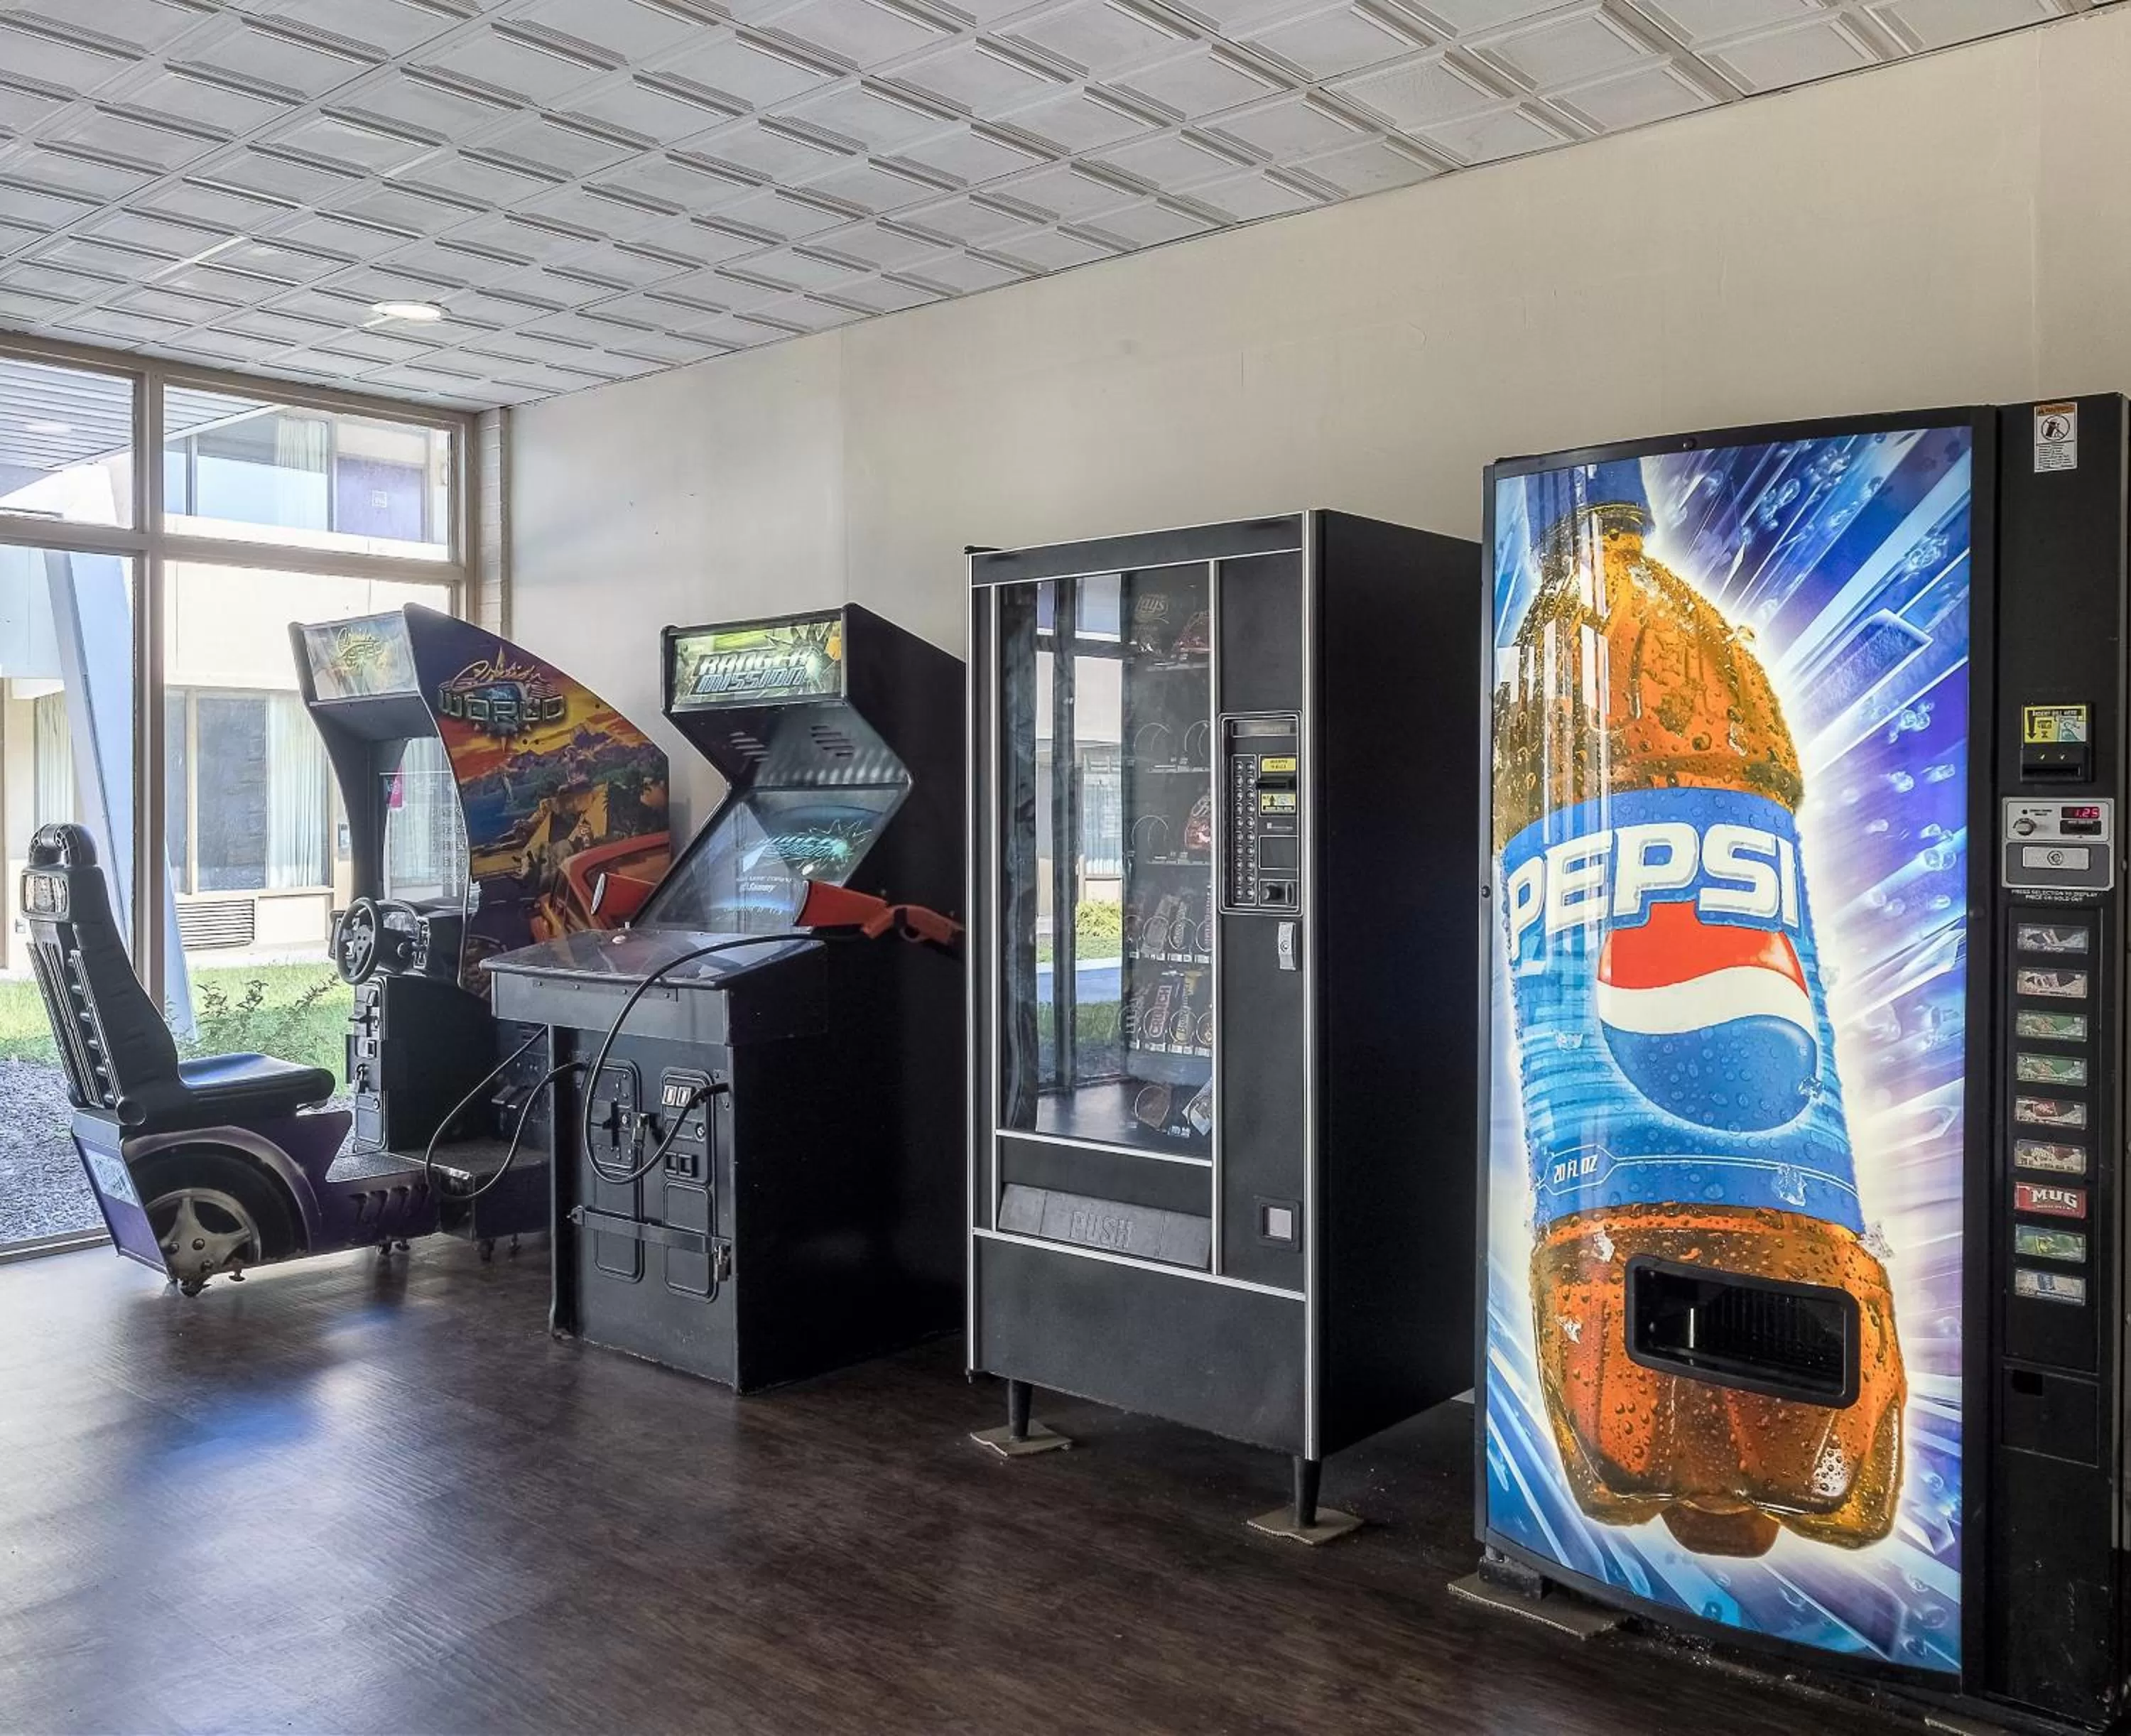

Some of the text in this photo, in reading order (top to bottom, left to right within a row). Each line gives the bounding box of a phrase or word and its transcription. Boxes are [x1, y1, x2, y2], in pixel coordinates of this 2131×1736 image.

[699, 649, 808, 676] RANGER
[696, 666, 808, 693] MISSION
[437, 688, 566, 725] WORLD
[1508, 822, 1800, 962] PEPSI
[1553, 1154, 1599, 1184] 20 FL OZ
[2031, 1188, 2078, 1208] MUG
[1069, 1210, 1134, 1250] PUSH
